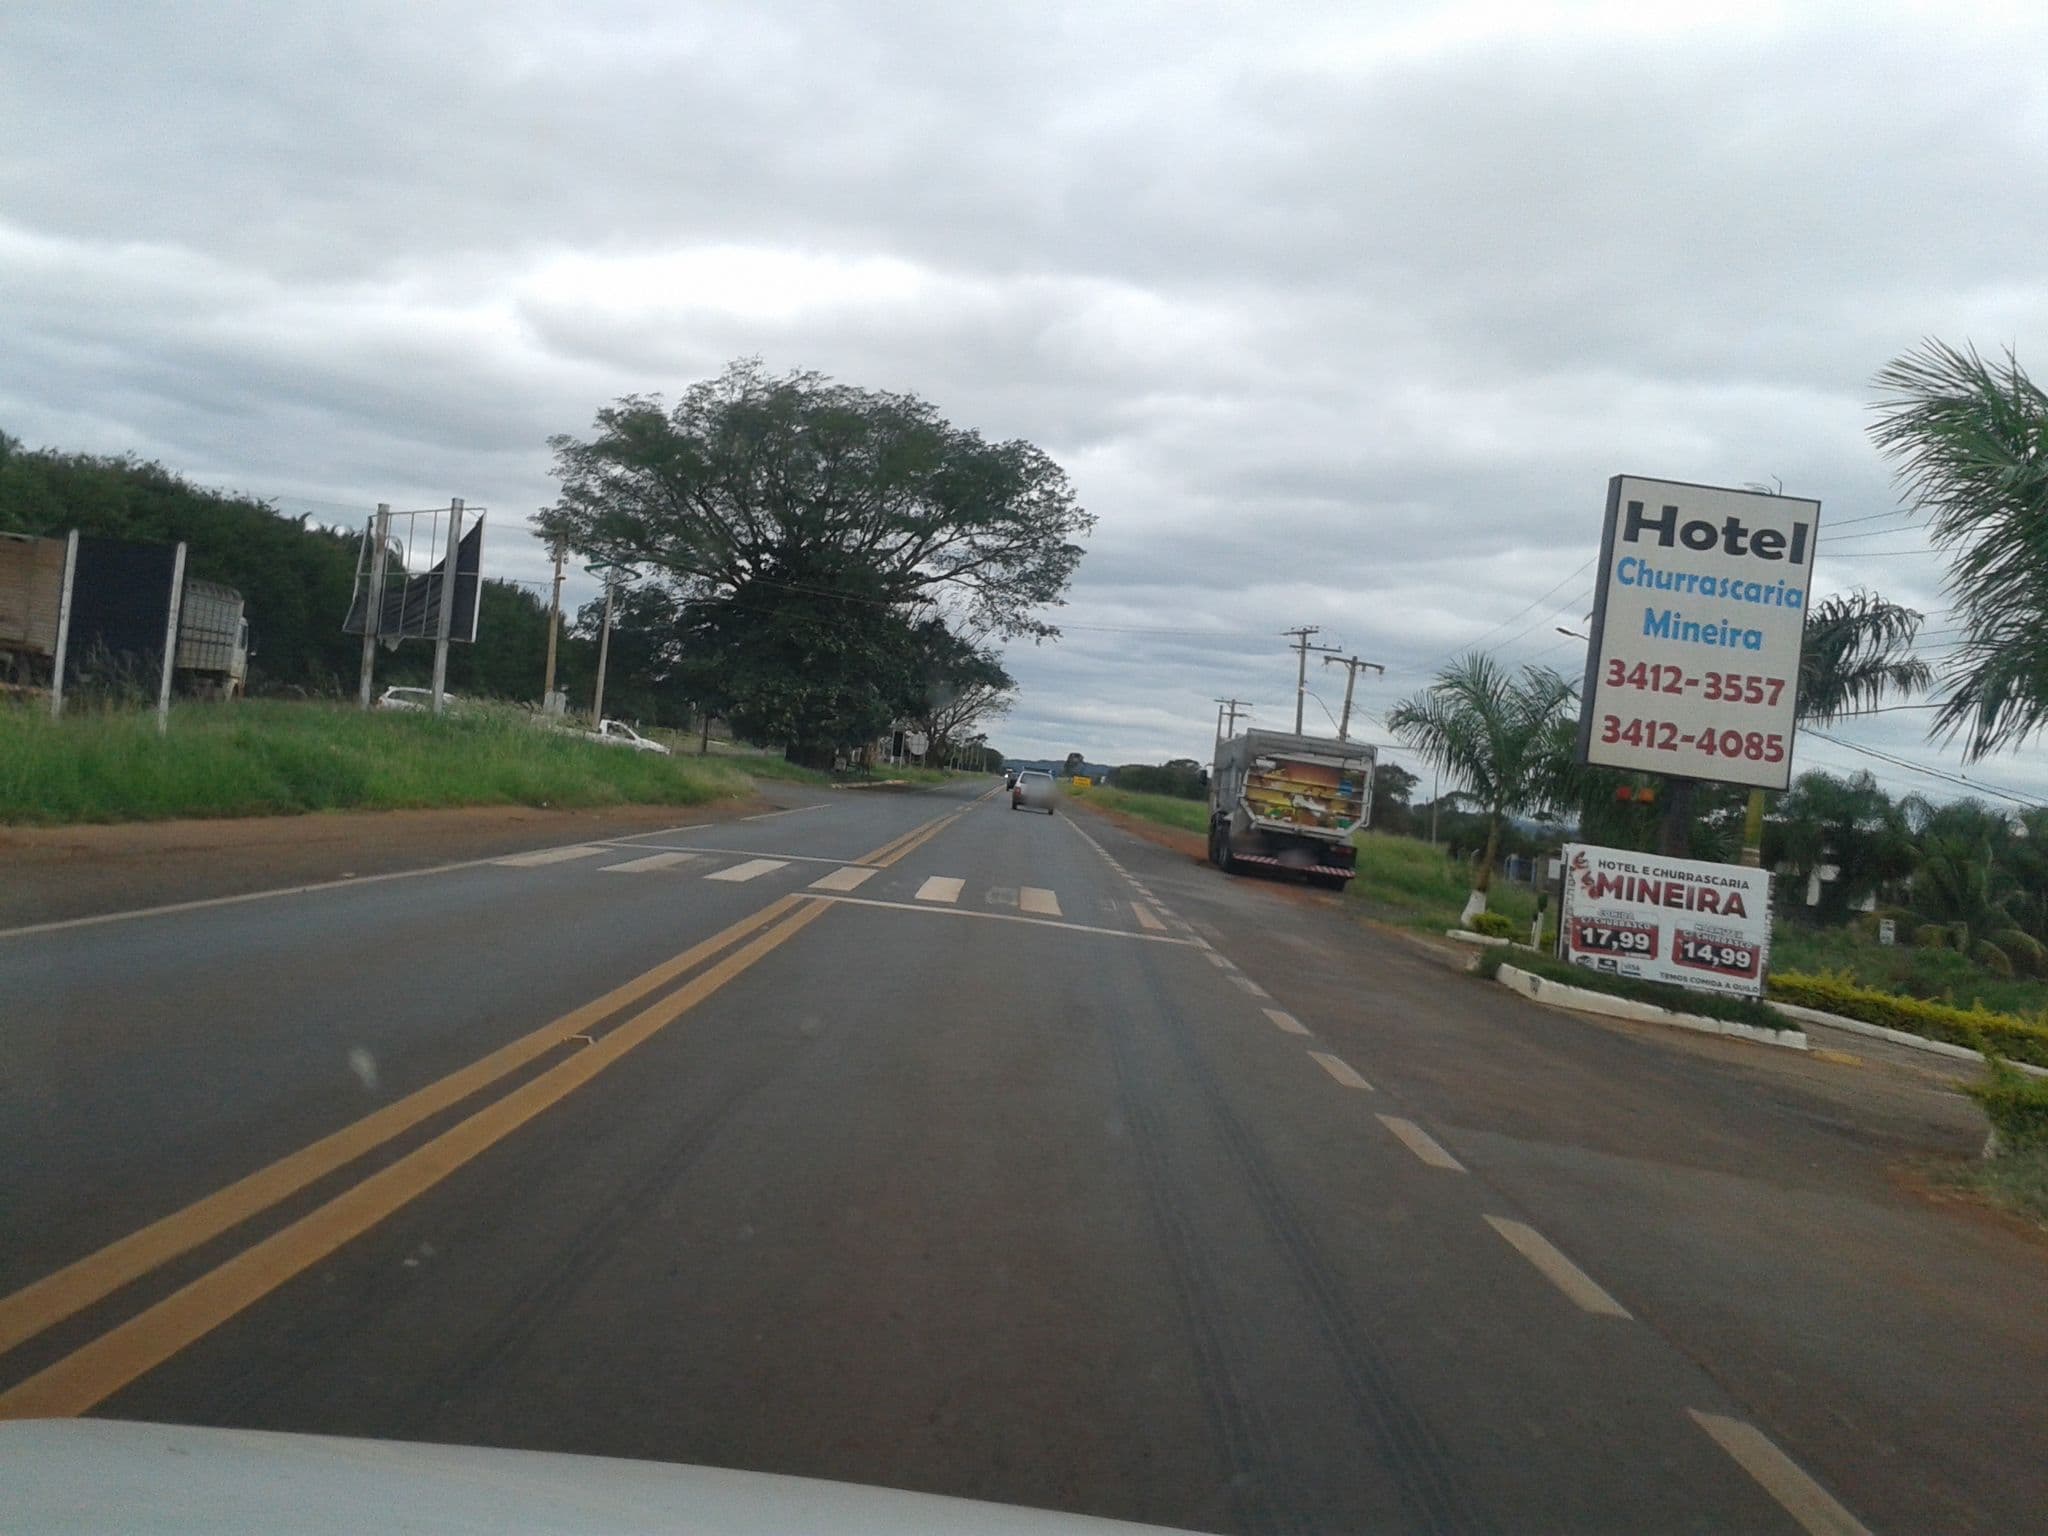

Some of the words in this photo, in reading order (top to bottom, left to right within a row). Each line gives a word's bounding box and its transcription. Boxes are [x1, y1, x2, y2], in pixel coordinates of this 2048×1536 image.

[1623, 500, 1809, 565] Hotel
[1616, 556, 1803, 608] Churrascaria
[1642, 607, 1762, 650] Mineira
[1605, 658, 1785, 707] 3412-3557
[1601, 714, 1784, 763] 3412-4085
[1595, 871, 1748, 919] MINEIRA
[1598, 858, 1638, 874] HOTEL
[1642, 866, 1650, 875] E
[1653, 867, 1750, 890] CHURRASCARIA
[1582, 927, 1650, 952] 17,99
[1683, 942, 1751, 968] 14,99
[1659, 971, 1689, 983] TEMOS
[1689, 976, 1723, 988] COMIDA
